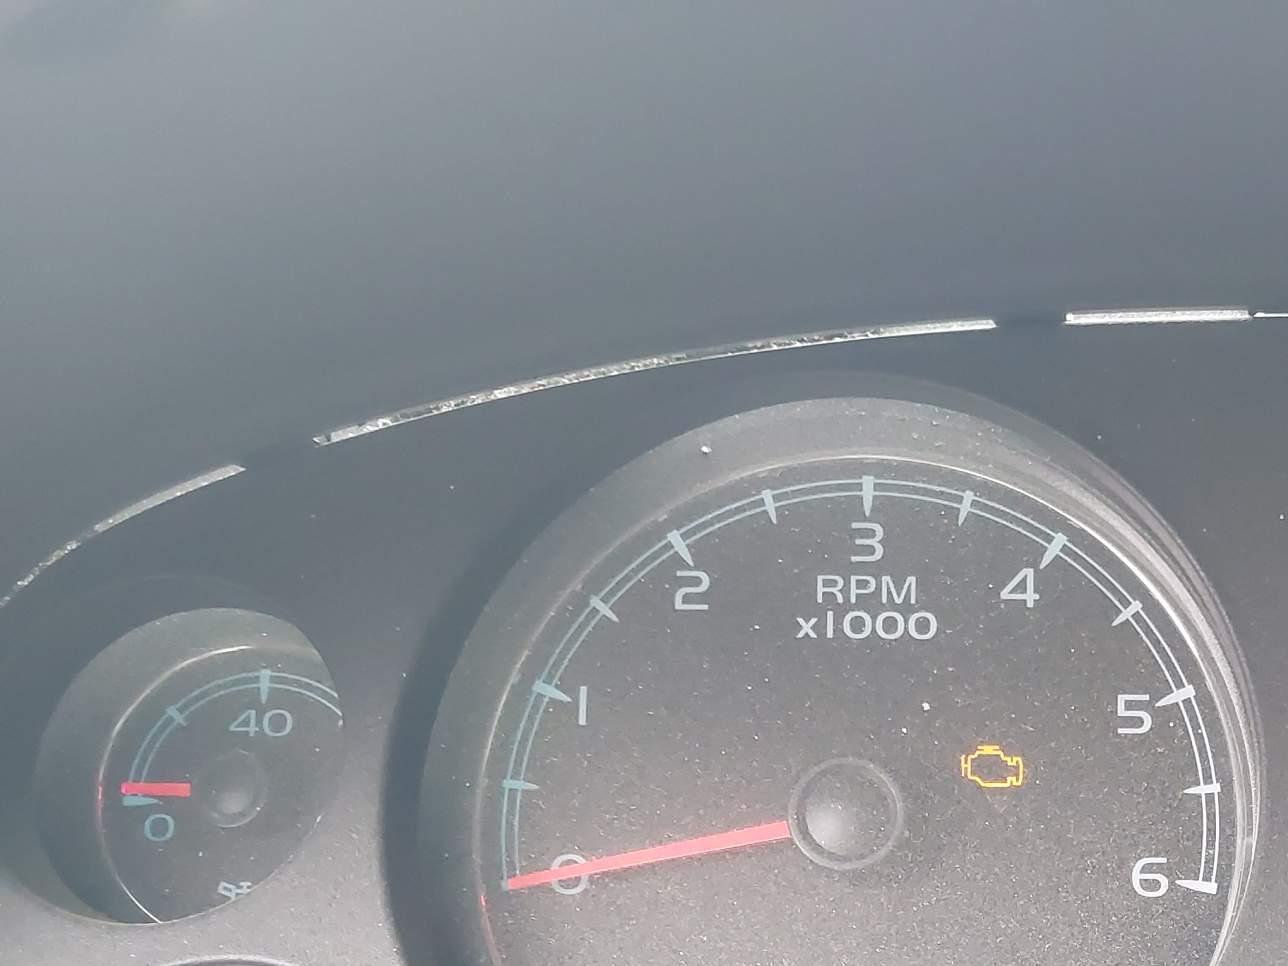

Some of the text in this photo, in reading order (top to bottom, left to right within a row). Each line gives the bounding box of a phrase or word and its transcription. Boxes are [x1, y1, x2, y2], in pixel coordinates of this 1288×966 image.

[850, 522, 885, 563] 3
[674, 570, 710, 611] 2
[816, 575, 917, 605] RPM
[1001, 568, 1039, 609] 4
[795, 612, 937, 641] x1000
[229, 708, 293, 737] 40
[577, 685, 589, 726] 1
[1117, 694, 1153, 735] 5
[143, 813, 175, 842] 0
[549, 854, 589, 896] 0
[1131, 857, 1170, 898] 6
